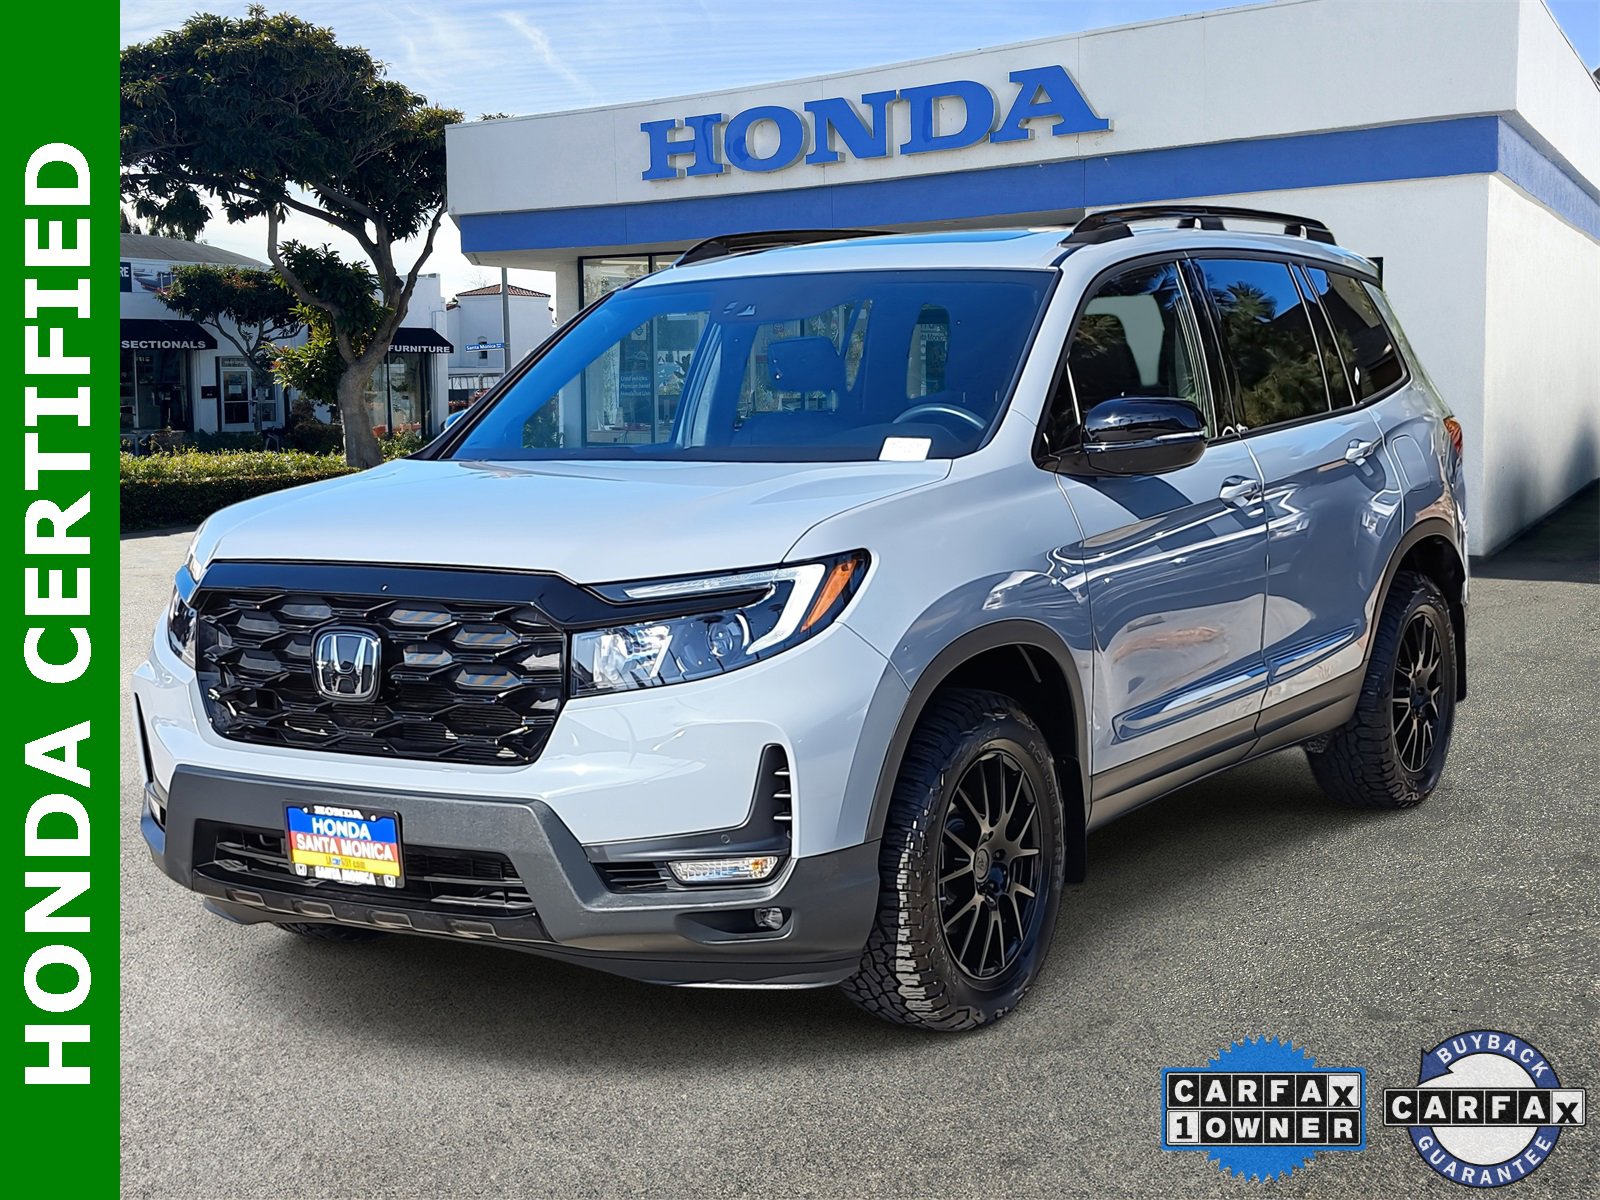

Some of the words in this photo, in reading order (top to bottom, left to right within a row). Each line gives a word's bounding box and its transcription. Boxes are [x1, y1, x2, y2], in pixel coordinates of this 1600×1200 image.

[641, 65, 1110, 181] HONDA
[121, 340, 206, 349] SECTIONALS
[388, 344, 450, 353] FURNITURE
[312, 817, 372, 841] HONDA
[296, 833, 340, 855] SANTA
[341, 839, 394, 861] MONICA
